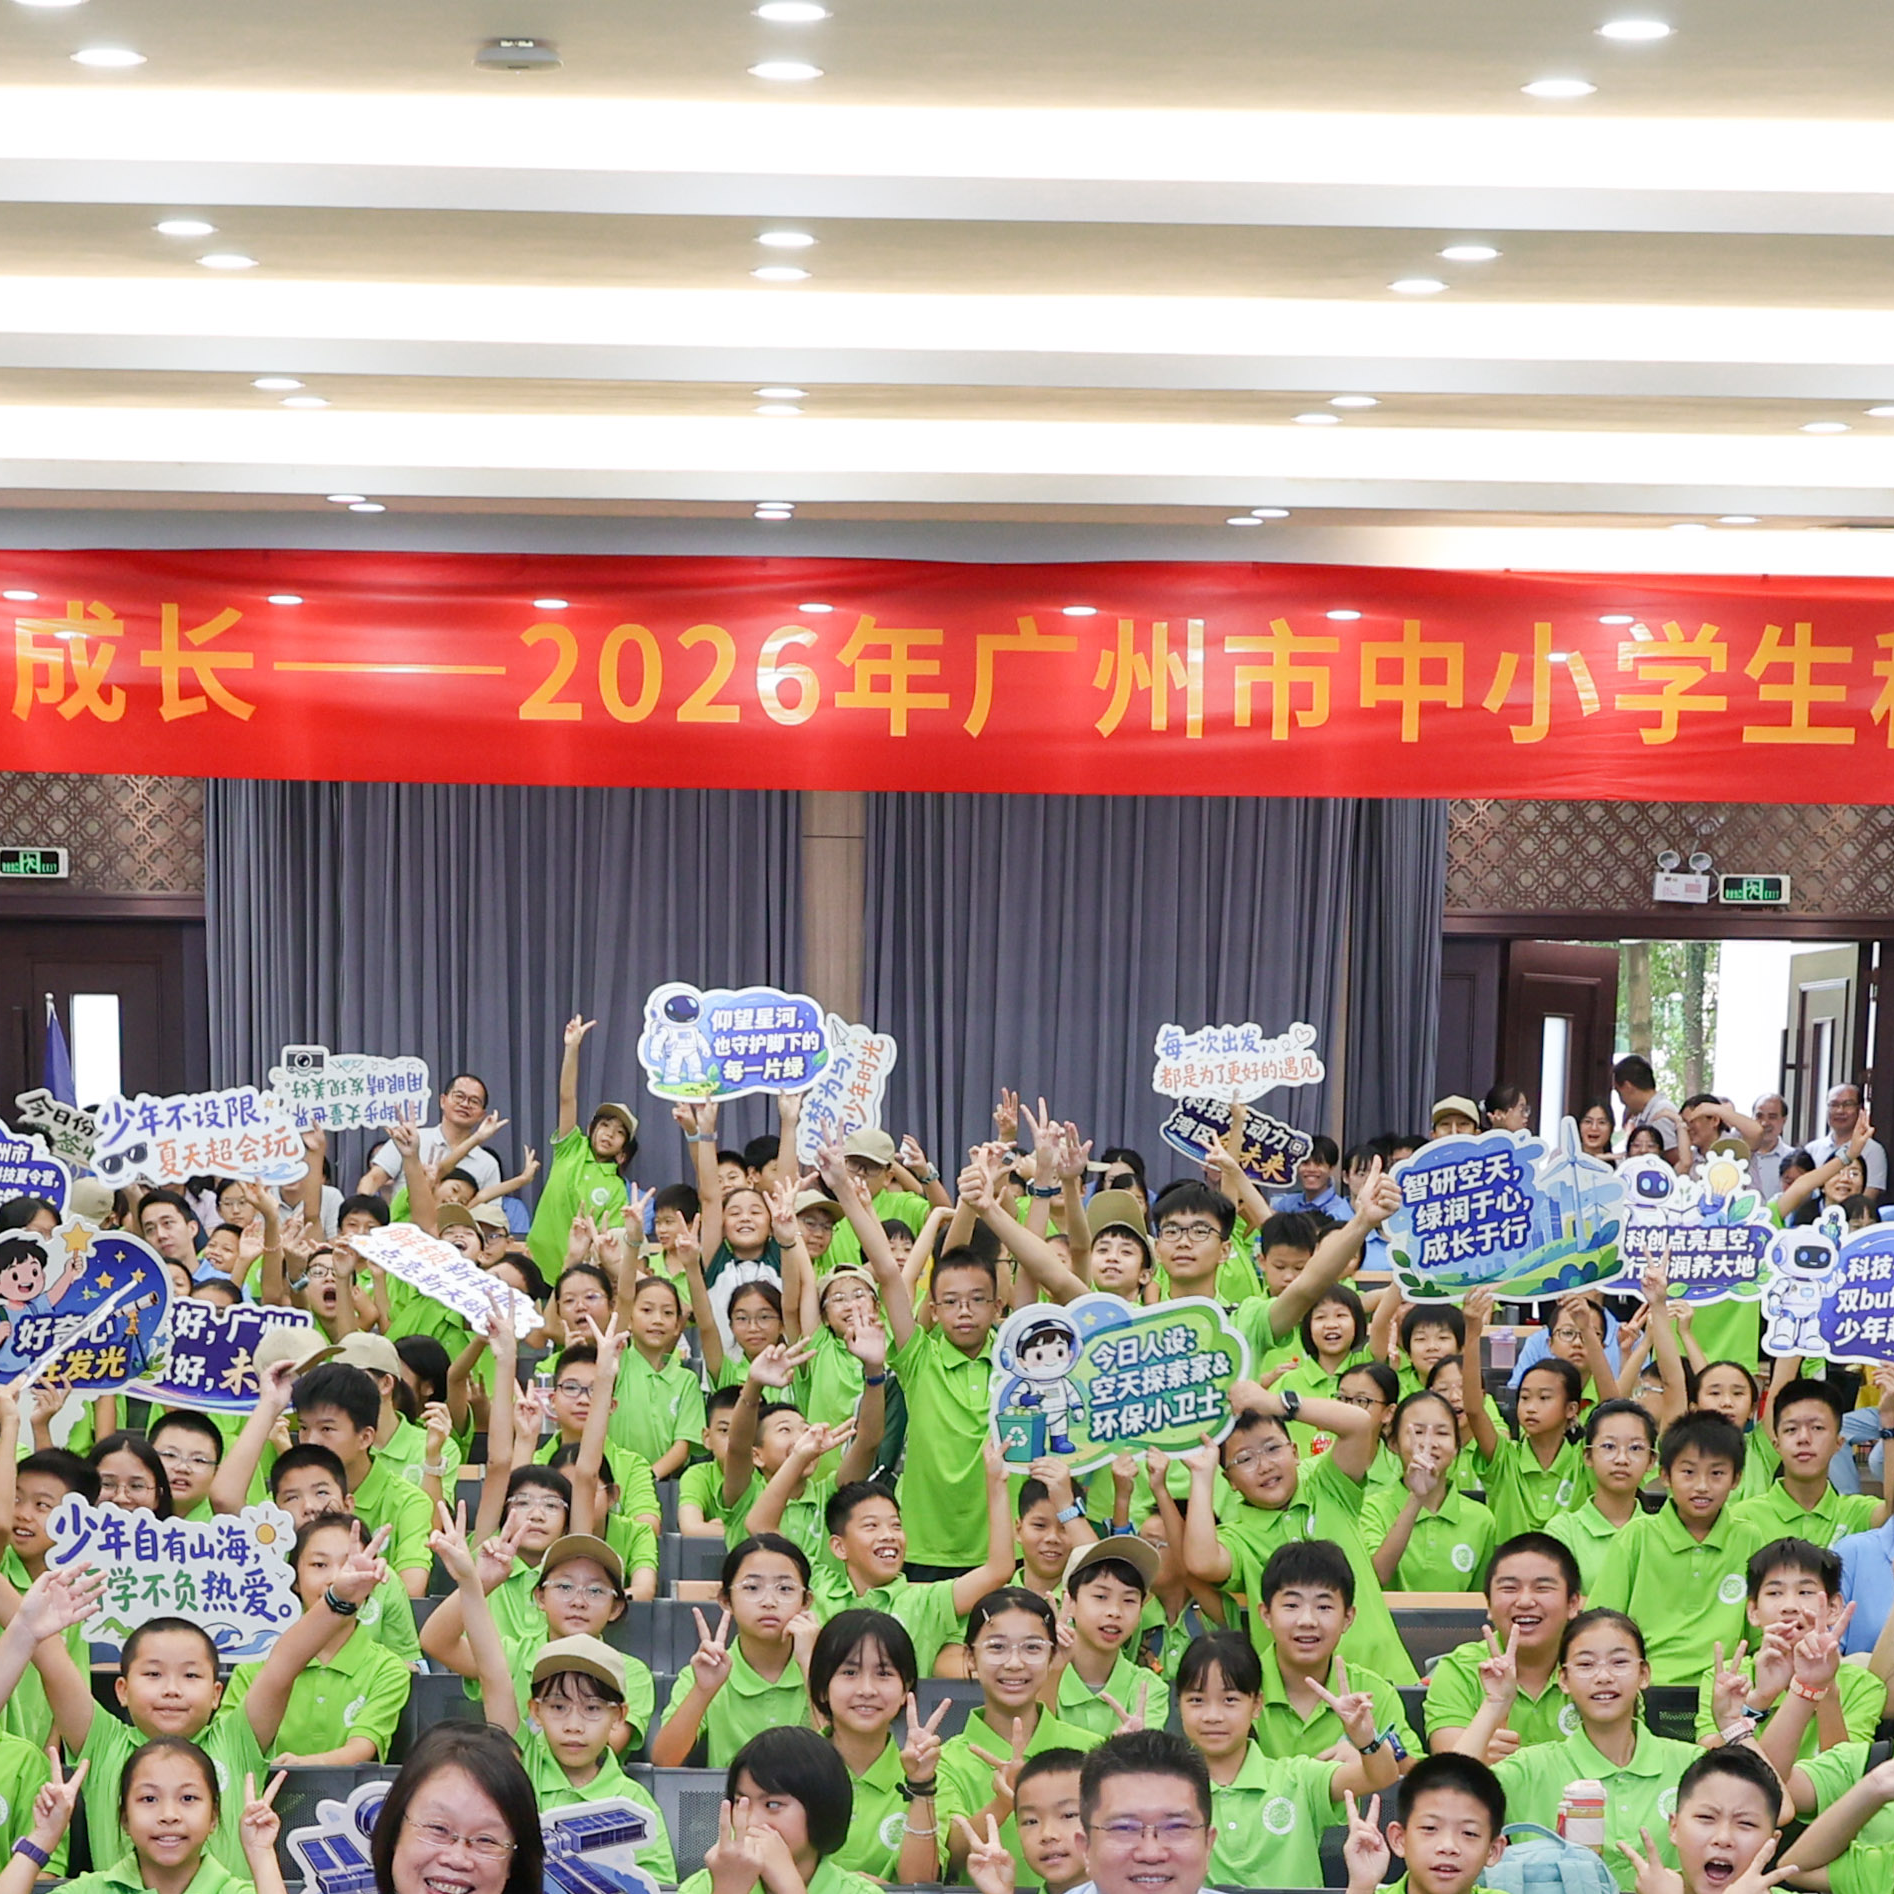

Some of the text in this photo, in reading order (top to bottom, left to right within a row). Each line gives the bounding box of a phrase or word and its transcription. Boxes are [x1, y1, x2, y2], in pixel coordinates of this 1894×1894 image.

[710, 1006, 805, 1033] 仰望星河，
[713, 1031, 820, 1058] 也守护脚下的
[1161, 1029, 1268, 1061] 每一次出发，
[723, 1056, 805, 1083] 每一片绿
[1159, 1056, 1320, 1092] 都是为了更好的遇见
[101, 1087, 271, 1148] 少年不设限，
[156, 1126, 300, 1179] 夏天超会玩
[1402, 1152, 1521, 1203] 智研空天，
[1415, 1185, 1533, 1232] 绿润于心，
[1421, 1221, 1527, 1265] 成长于行
[1091, 1326, 1197, 1372] 今日人设：
[1090, 1352, 1230, 1407] 空天探索家&
[1090, 1385, 1223, 1441] 环保小卫士
[55, 1503, 261, 1567] 少年自有山海，
